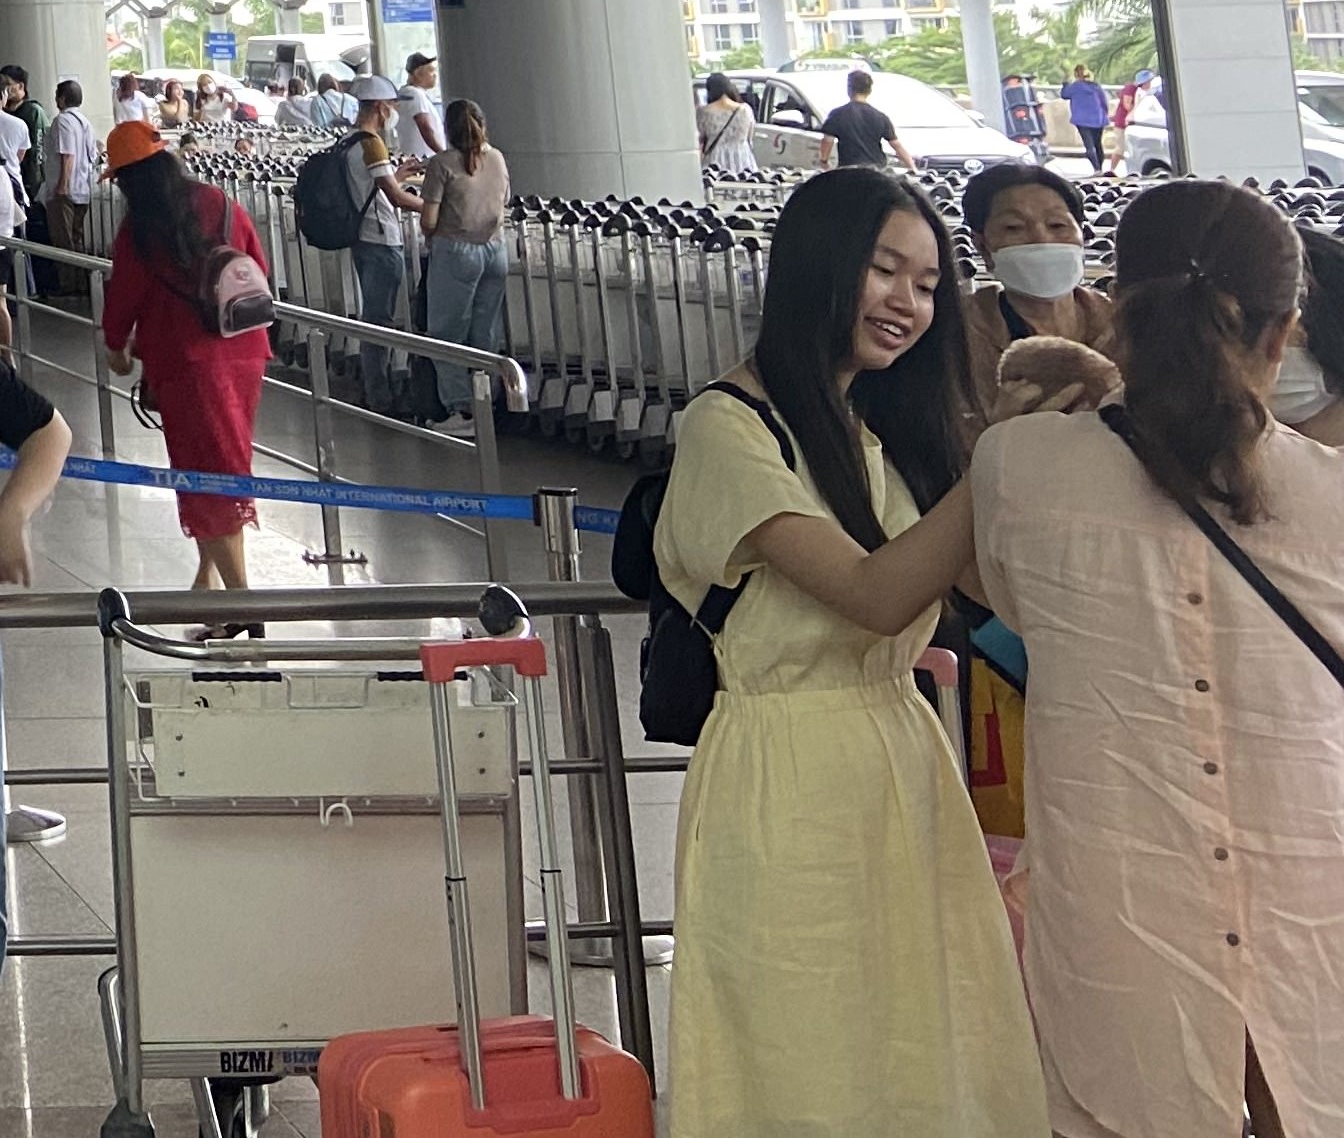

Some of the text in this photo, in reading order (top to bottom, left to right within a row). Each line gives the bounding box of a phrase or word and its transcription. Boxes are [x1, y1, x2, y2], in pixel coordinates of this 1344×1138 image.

[150, 470, 192, 488] TIA
[335, 490, 429, 507] INTERNATIONAL
[433, 497, 488, 510] AIRPORT
